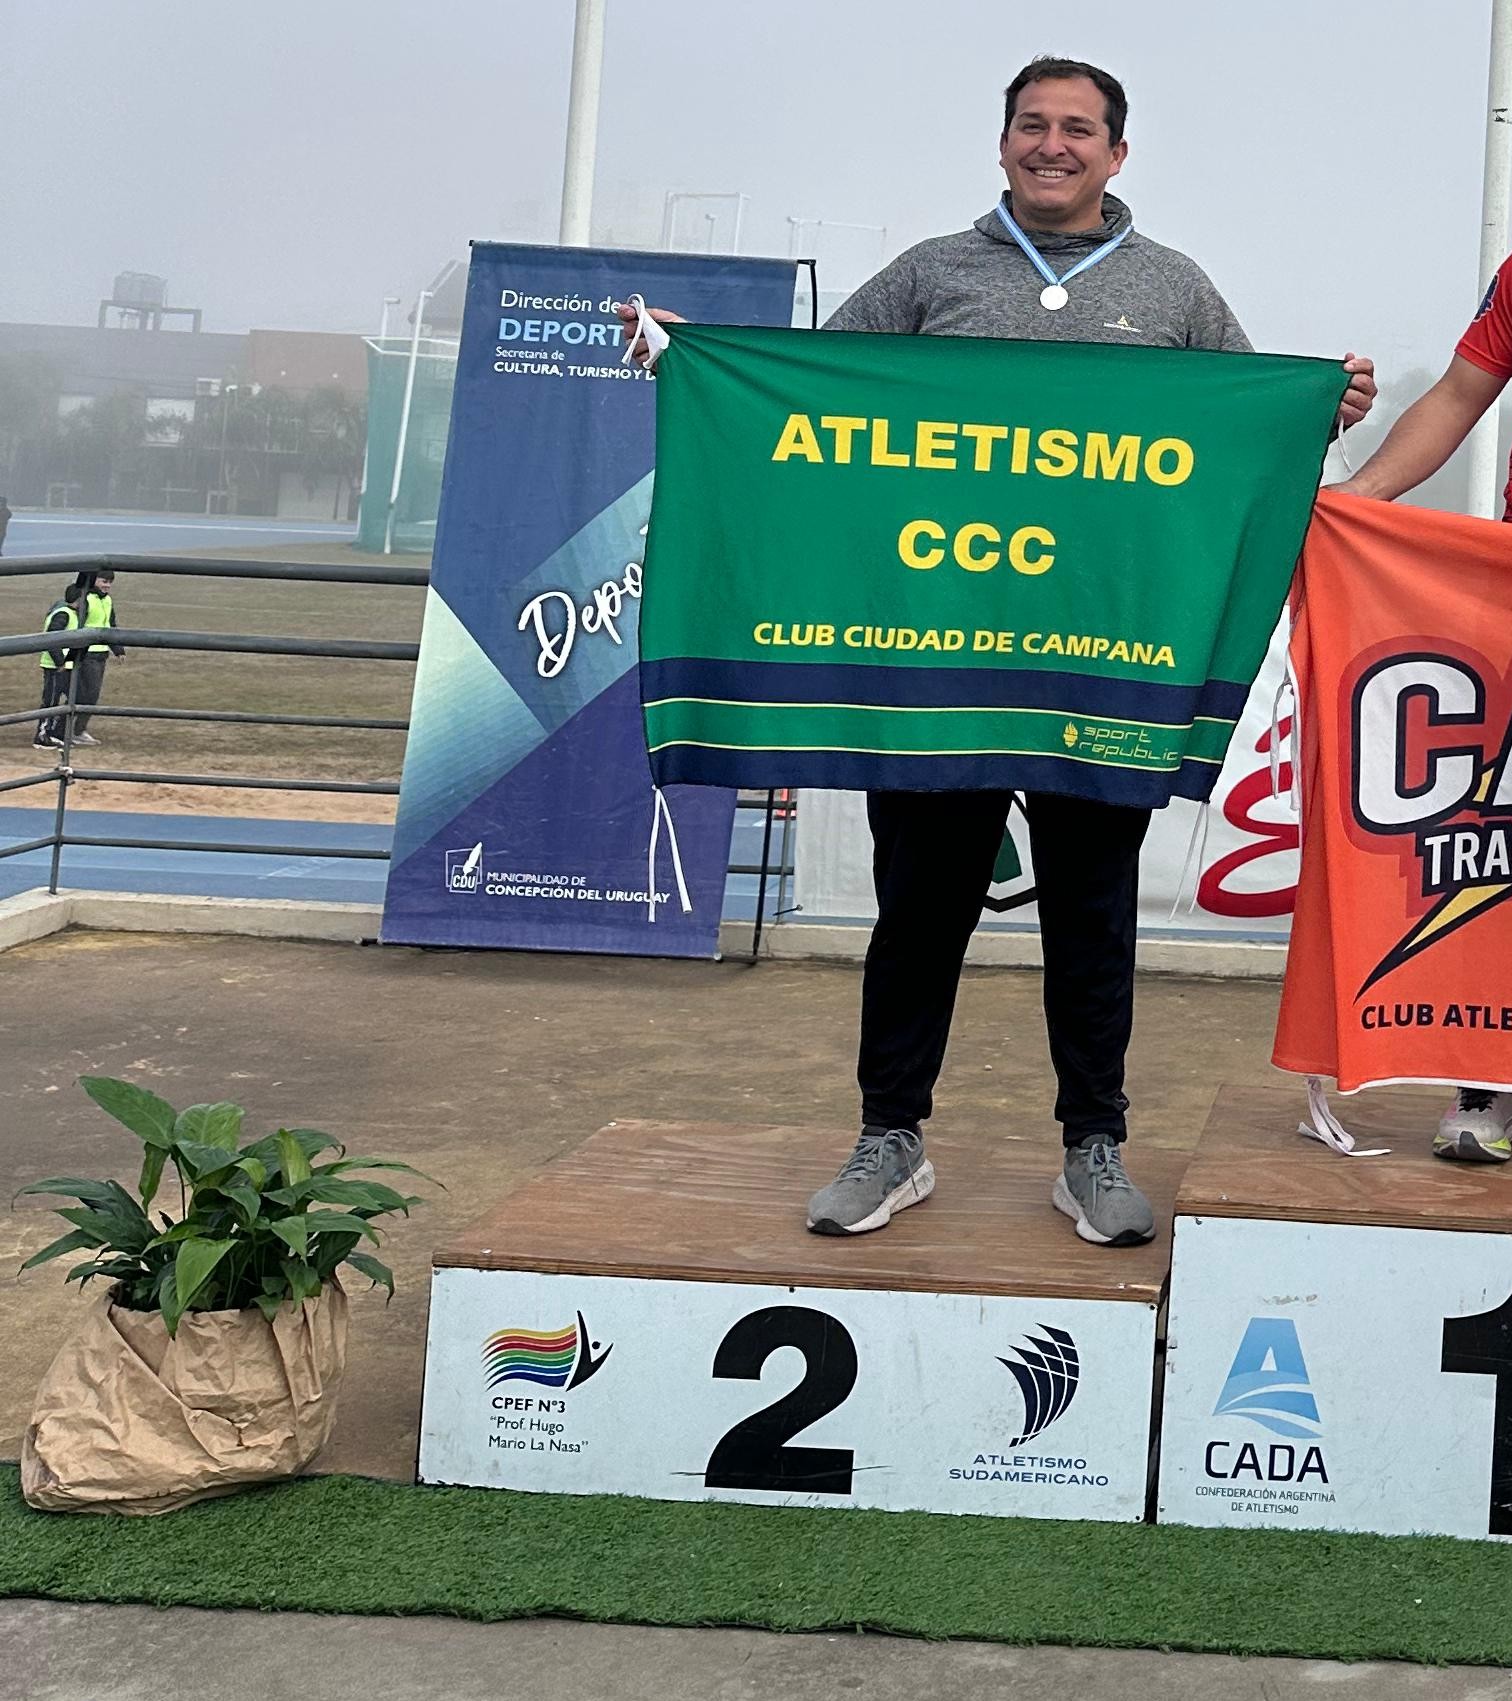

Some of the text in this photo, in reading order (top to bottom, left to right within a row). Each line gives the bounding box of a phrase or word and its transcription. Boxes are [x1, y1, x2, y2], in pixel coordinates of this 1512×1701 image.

[500, 289, 621, 314] Dirección de
[551, 350, 565, 361] de
[494, 362, 564, 377] CULTURA,
[567, 365, 631, 379] TURISMO
[632, 370, 643, 380] Y
[771, 413, 1195, 486] ATLETISMO
[898, 519, 1056, 576] CCC
[753, 622, 1176, 668] CLUB CIUDAD DE CAMPANA
[1083, 726, 1152, 743] sport
[1079, 741, 1178, 761] republic
[453, 874, 475, 889] CDU
[486, 871, 586, 887] MUNICIPALIDAD DE
[485, 884, 574, 899] CONCEPCIÓN
[577, 889, 603, 900] DEL
[1360, 1004, 1433, 1031] CLUB
[492, 1396, 533, 1411] CPEF
[704, 1305, 858, 1495] 2
[530, 1418, 564, 1435] Hugo
[489, 1434, 526, 1449] Mario
[530, 1438, 544, 1450] La
[973, 1454, 1087, 1469] ATLETISMO
[1205, 1441, 1329, 1483] CADA
[949, 1468, 1109, 1486] SUDAMERICANO
[1195, 1486, 1336, 1503] CONFEDERACIÓN ARGENTINA
[1231, 1502, 1299, 1514] DE ATLETISMO
